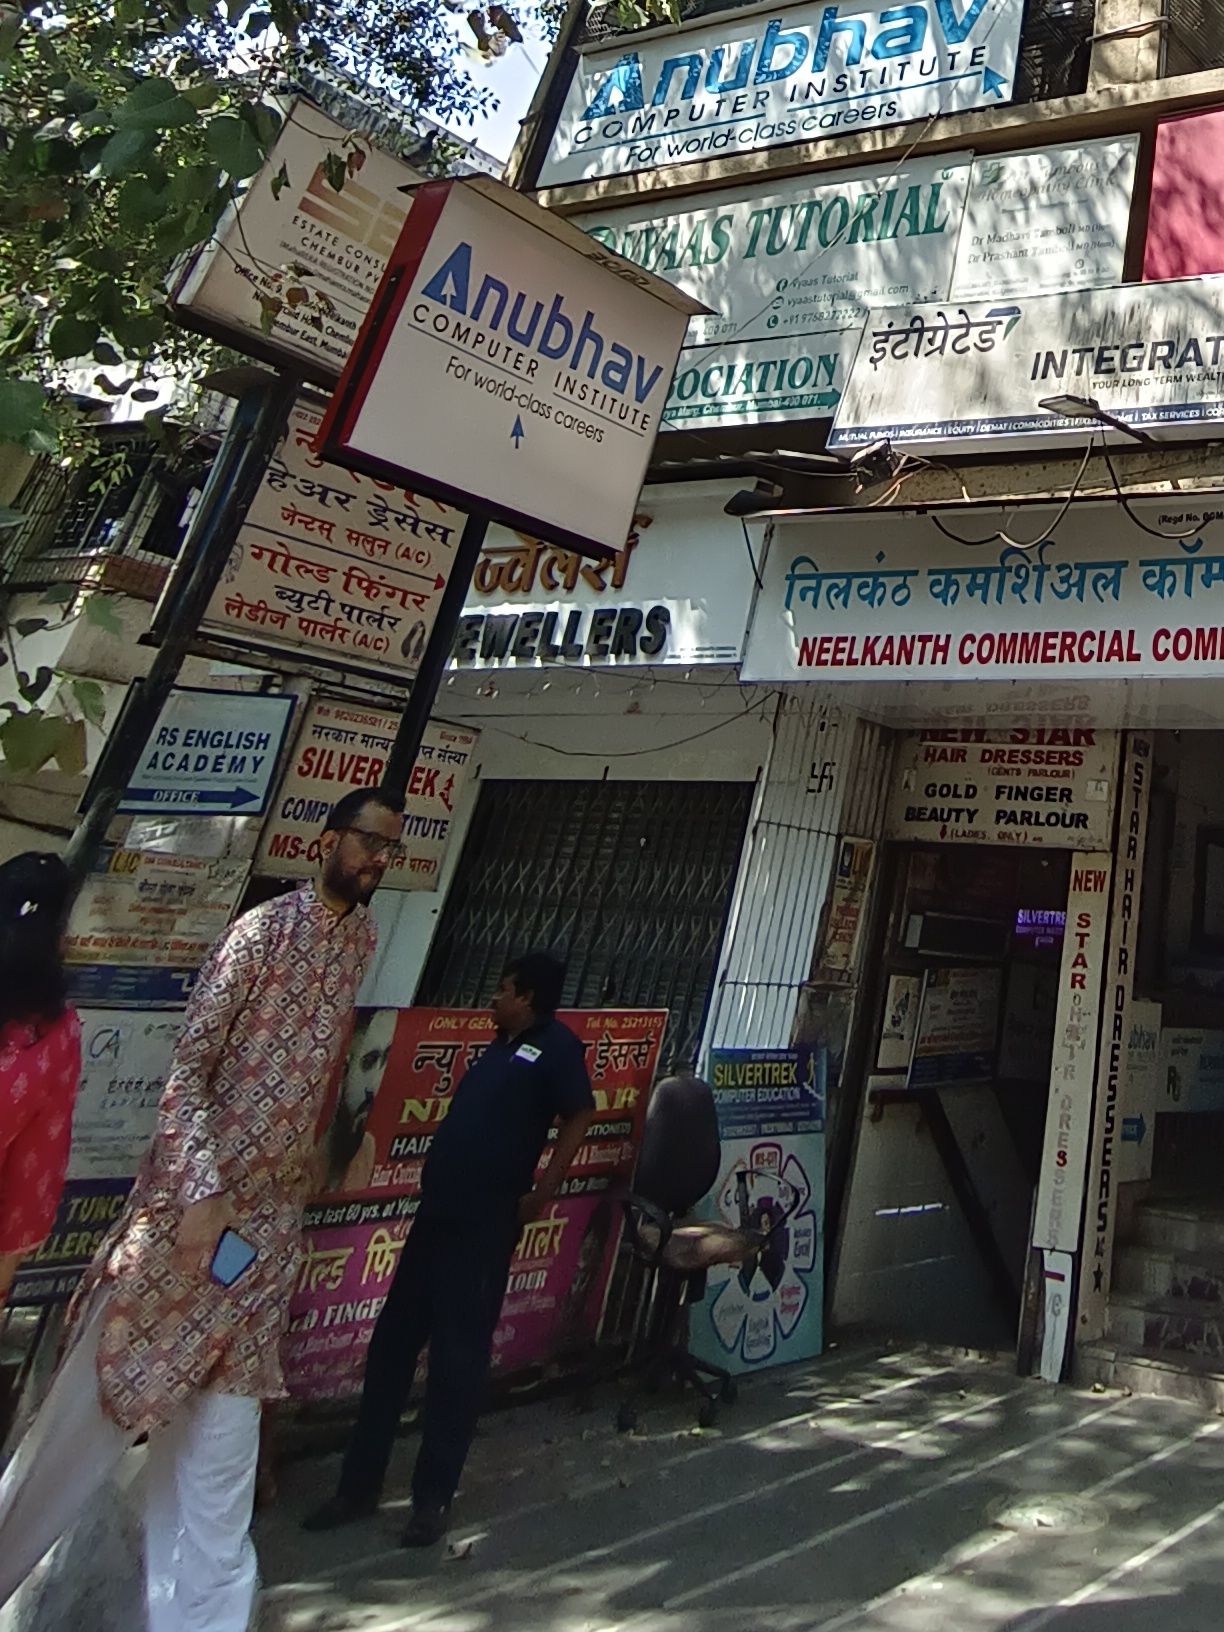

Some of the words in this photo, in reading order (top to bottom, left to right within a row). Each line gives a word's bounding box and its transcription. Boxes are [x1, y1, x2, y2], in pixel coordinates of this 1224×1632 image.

[573, 90, 771, 146] COMPUTER
[789, 45, 987, 103] INSTITUTE
[625, 143, 658, 166] For
[667, 119, 798, 159] world-class
[801, 100, 898, 133] careers
[291, 215, 340, 246] ESTATE
[621, 214, 734, 273] VYAAS
[742, 181, 951, 260] TUTORIAL
[301, 236, 362, 274] CHEMBUR
[821, 271, 859, 285] Tutorial
[420, 241, 665, 405] Anubhav
[412, 303, 540, 378] COMPUTER
[554, 371, 651, 432] INSTITUTE
[1092, 380, 1120, 390] YOUR
[1121, 377, 1151, 388] LONG
[445, 355, 473, 381] For
[474, 371, 553, 420] world-class
[554, 409, 606, 443] careers
[265, 456, 357, 512] हेअर
[366, 494, 456, 548] ड्रेसेस
[345, 527, 392, 558] सलुन
[395, 542, 431, 568] (A/C)
[250, 540, 338, 584] गोल्ड
[342, 566, 431, 612] फिंगर
[784, 550, 920, 612] निलकंठ
[928, 539, 1133, 608] कमर्शिअल
[224, 592, 292, 631] लेडीज
[297, 616, 352, 646] पार्लर
[352, 629, 391, 655] (A/C)
[274, 584, 336, 617] ब्युटी
[339, 605, 402, 634] पार्लर
[451, 604, 672, 660] EWELLERS
[797, 631, 951, 667] NEELKANTH
[957, 628, 1142, 665] COMMERCIAL
[156, 726, 180, 747] RS
[182, 729, 271, 750] ENGLISH
[312, 724, 358, 745] सरकार
[924, 747, 968, 764] HAIR
[980, 748, 1084, 767] DRESSERS
[146, 751, 265, 774] ACADEMY
[297, 747, 441, 798] SILVEREK
[152, 790, 201, 803] OFFICE
[924, 783, 978, 799] GOLD
[994, 785, 1074, 803] FINGER
[1126, 763, 1145, 861] STAR
[904, 806, 980, 824] BEAUTY
[994, 809, 1090, 829] PARLOUR
[1072, 870, 1107, 893] NEW
[1017, 908, 1067, 926] SILVERTRE
[1118, 868, 1135, 976] HAIR
[1070, 913, 1091, 990] STAR
[428, 1016, 466, 1032] (ONLY
[412, 1041, 465, 1096] न्यु
[713, 1061, 798, 1087] SILVERTREK
